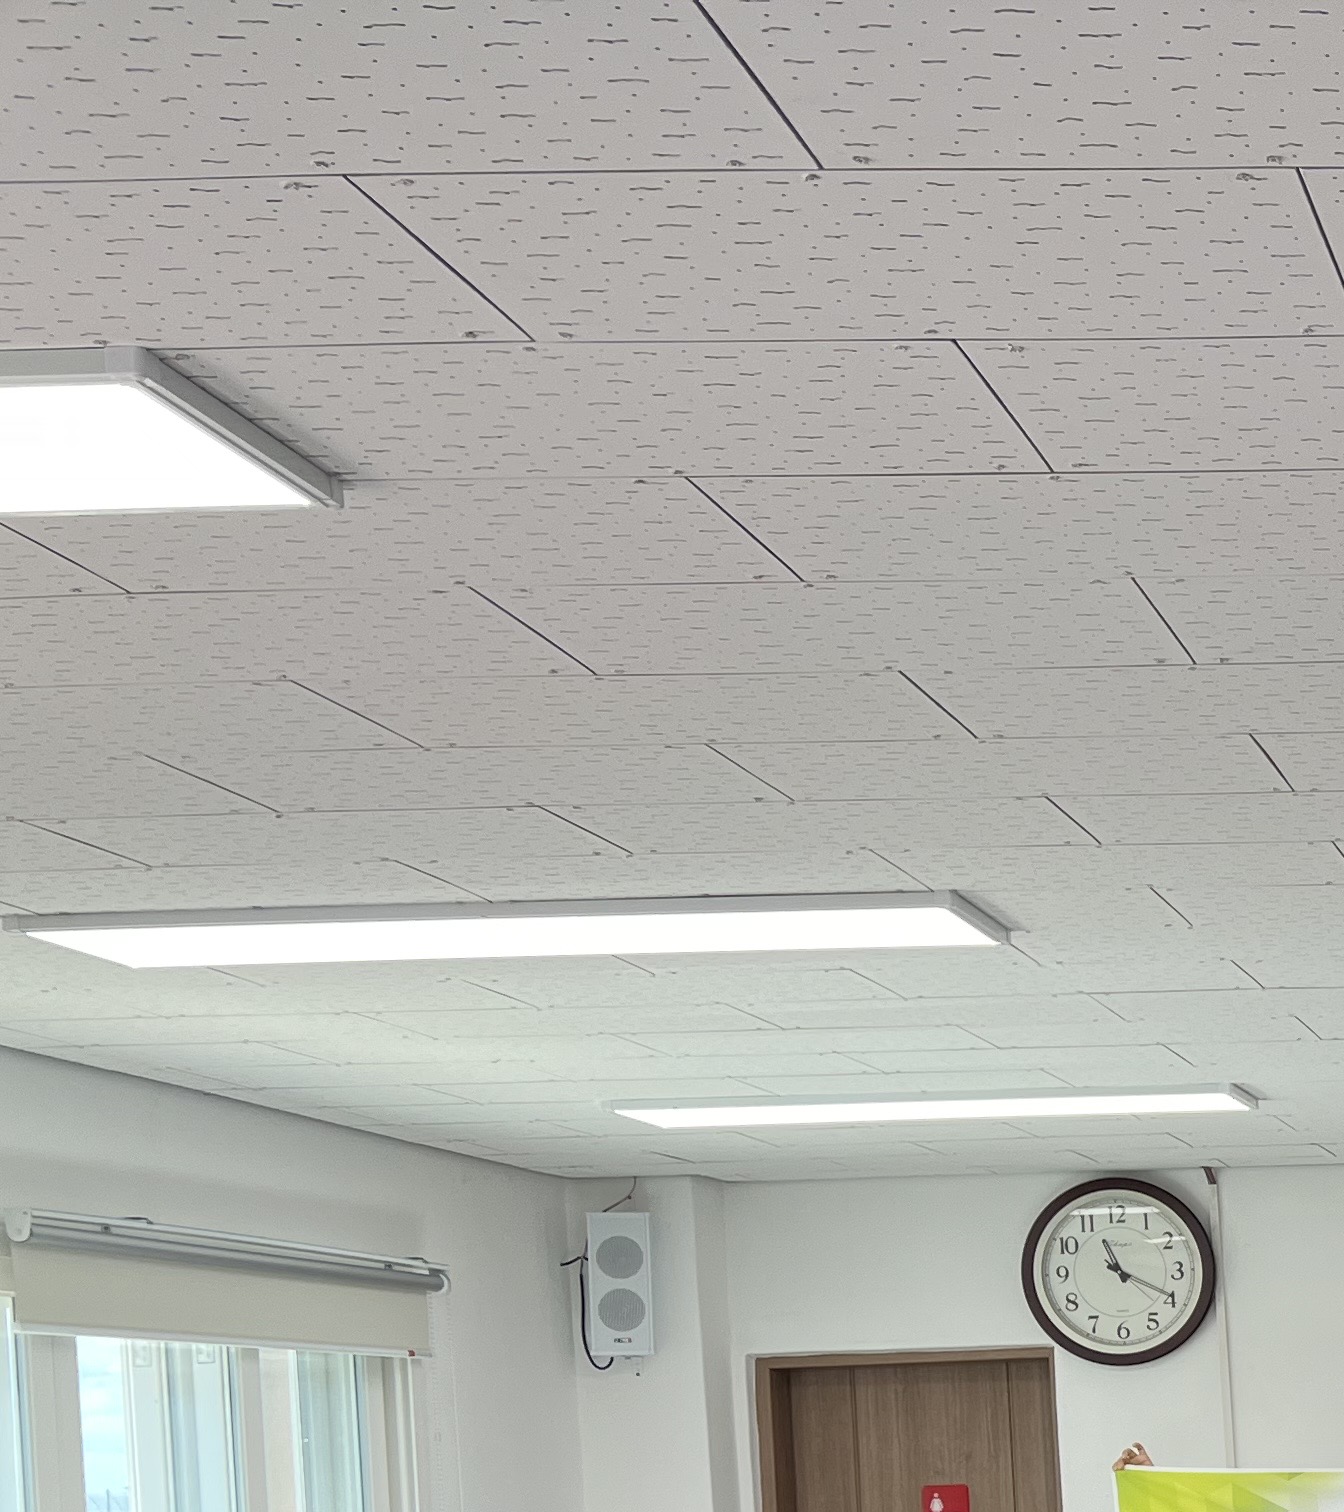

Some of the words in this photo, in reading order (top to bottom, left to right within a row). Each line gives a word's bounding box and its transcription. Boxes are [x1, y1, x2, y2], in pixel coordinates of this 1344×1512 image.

[1080, 1214, 1095, 1232] 11
[1108, 1205, 1126, 1224] 12
[1143, 1212, 1149, 1230] 1
[1059, 1236, 1079, 1255] 10
[1162, 1231, 1174, 1250] 2
[1056, 1265, 1069, 1284] 9
[1171, 1261, 1184, 1280] 3
[1065, 1292, 1079, 1311] 8
[1163, 1290, 1176, 1308] 4
[1087, 1315, 1099, 1334] 7
[1117, 1320, 1131, 1339] 6
[1146, 1312, 1160, 1331] 5
